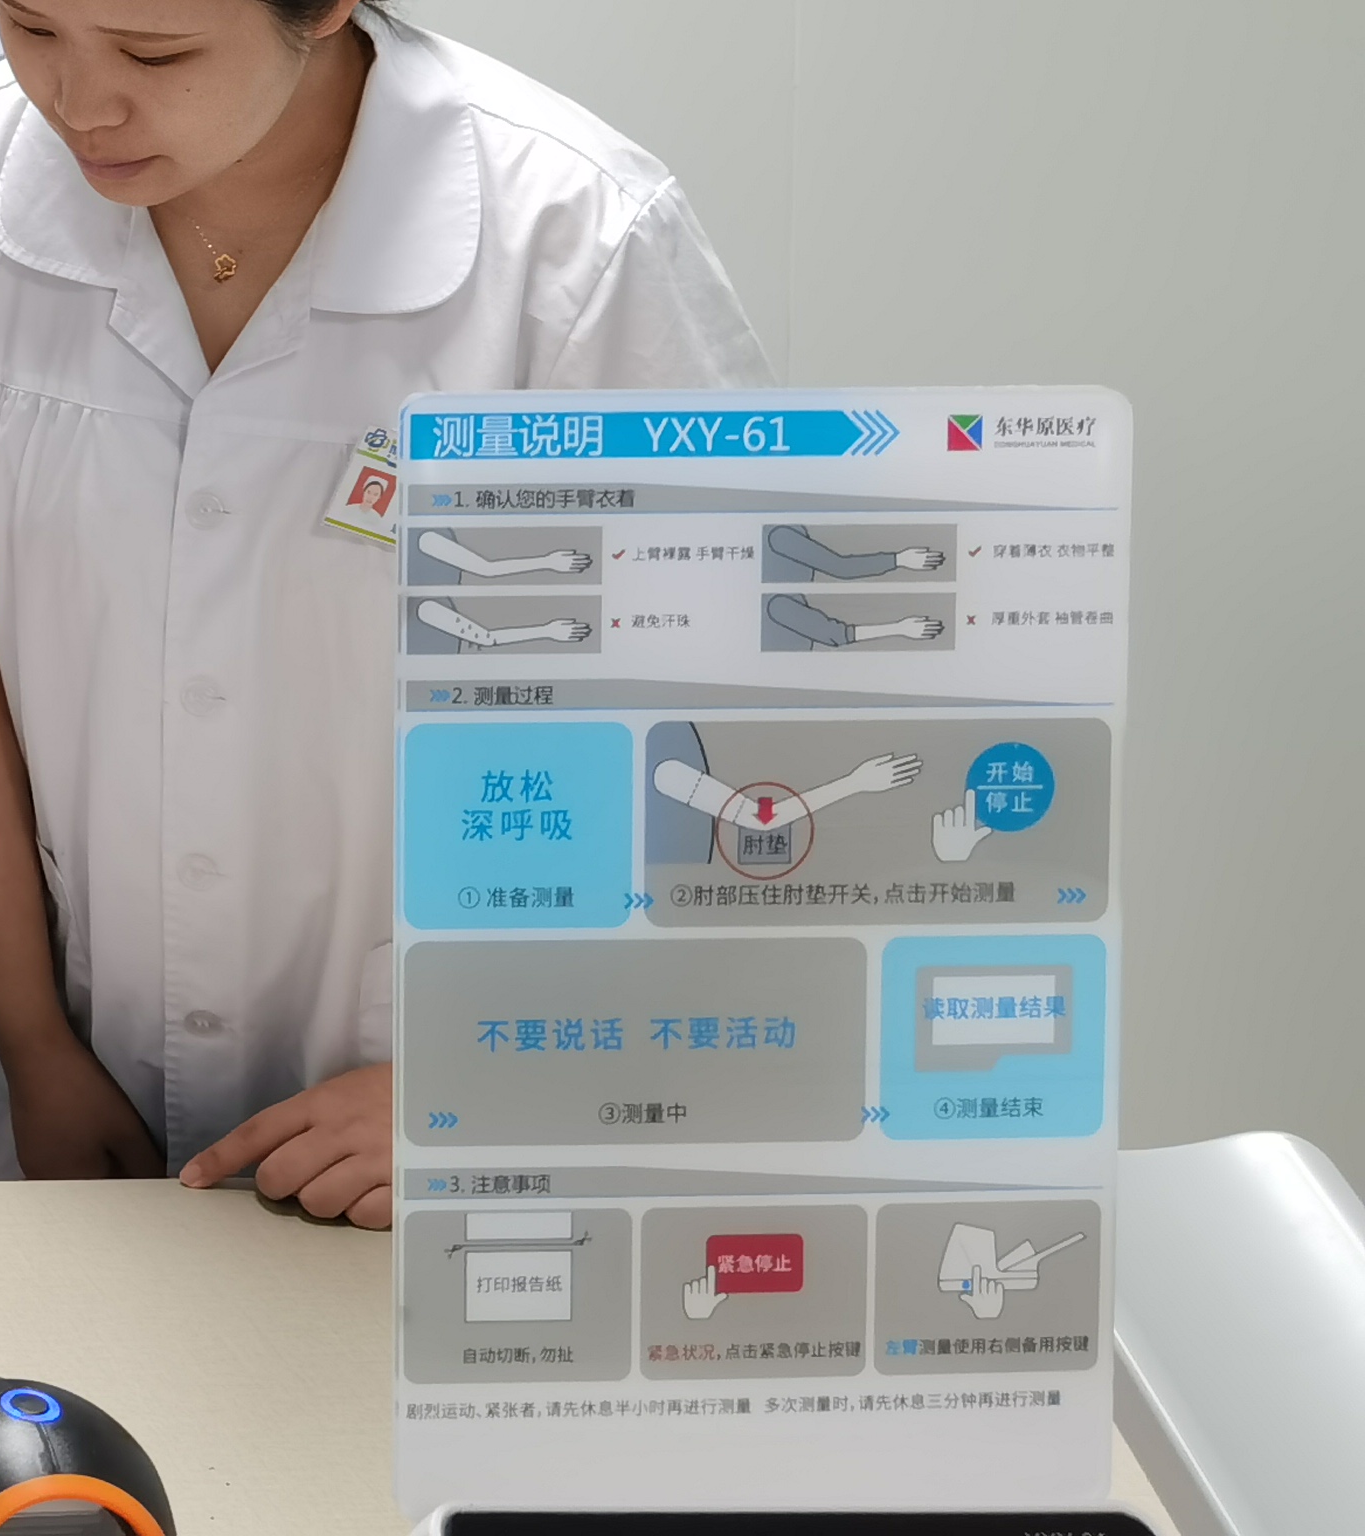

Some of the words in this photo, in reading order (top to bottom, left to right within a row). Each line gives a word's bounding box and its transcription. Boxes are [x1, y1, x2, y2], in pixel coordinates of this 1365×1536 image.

[432, 414, 604, 458] 测量说明
[643, 415, 792, 453] YXY-61
[995, 416, 1097, 437] 东华原医疗
[475, 488, 635, 510] 确认您的手臂衣着
[631, 613, 690, 629] 避免汗珠
[473, 685, 554, 707] 测量过程
[985, 761, 1034, 783] 开始
[480, 768, 554, 804] 放松
[985, 791, 1034, 813] 停止
[461, 808, 573, 842] 深呼吸
[741, 832, 789, 857] 肘垫
[922, 995, 1066, 1020] 读取测量结果
[476, 1018, 624, 1052] 不要说话
[650, 1016, 796, 1050] 不要活动
[471, 1173, 551, 1195] 注意事项
[717, 1254, 792, 1273] 紧急停止
[476, 1274, 563, 1294] 打印报告纸
